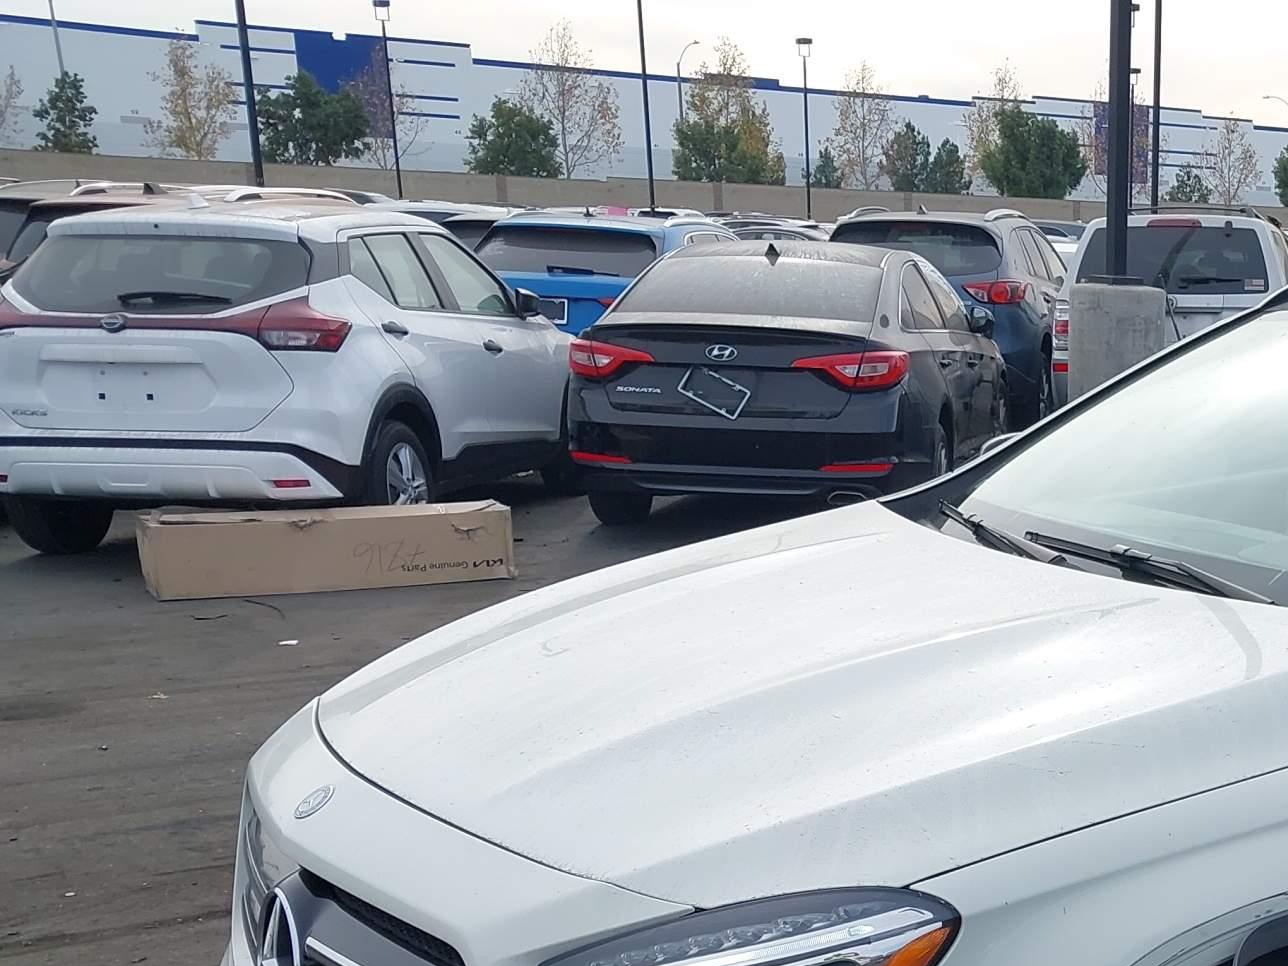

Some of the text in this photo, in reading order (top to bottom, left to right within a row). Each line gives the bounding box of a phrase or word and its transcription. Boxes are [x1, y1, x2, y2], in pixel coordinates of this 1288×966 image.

[615, 386, 662, 394] SONATA
[11, 408, 48, 416] KICKS
[401, 563, 427, 572] Parts
[429, 560, 468, 569] Genuine
